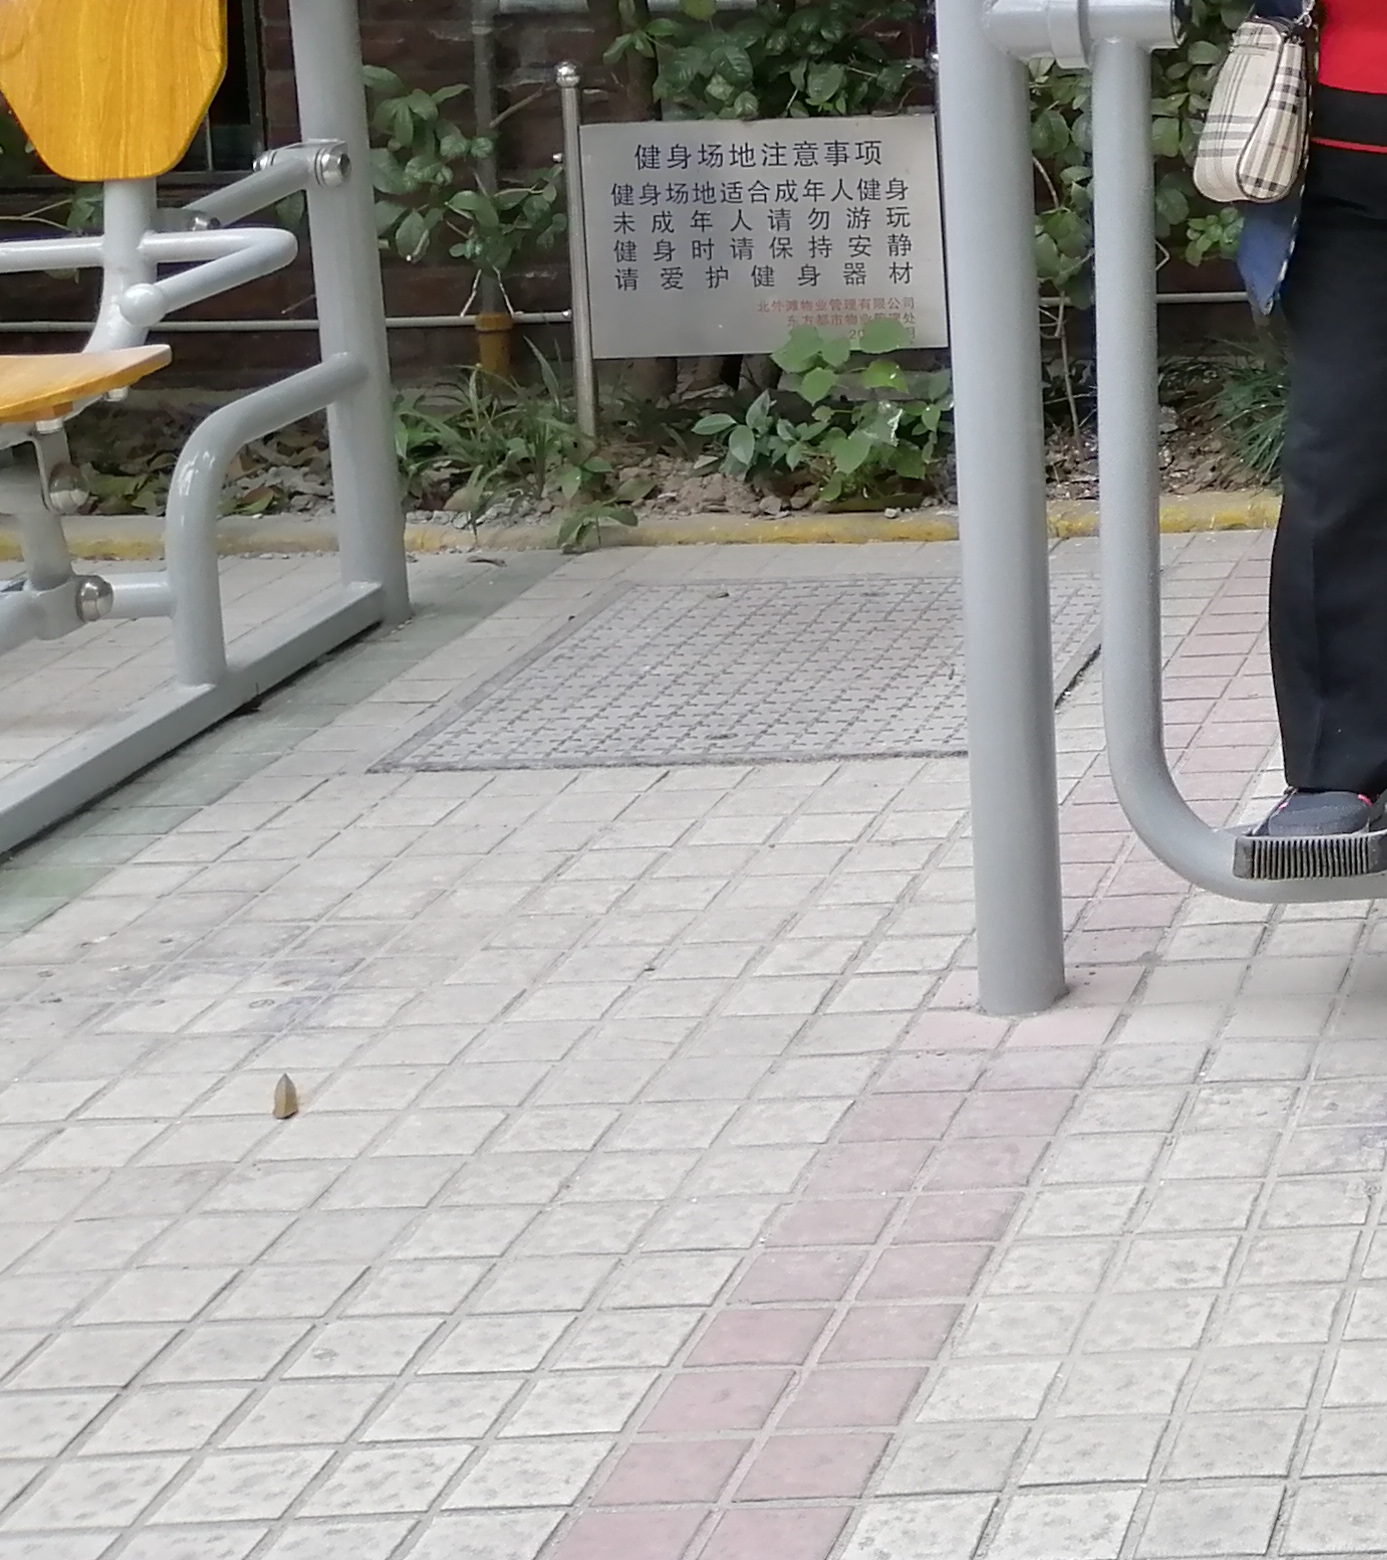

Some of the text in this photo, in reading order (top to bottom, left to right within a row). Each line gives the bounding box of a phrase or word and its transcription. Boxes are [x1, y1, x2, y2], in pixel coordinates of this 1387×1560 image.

[634, 139, 883, 171] 健身场地注意事项
[610, 177, 910, 206] 健身场地适合成年人健身
[613, 206, 912, 235] 未成年人请勿游玩
[614, 234, 913, 263] 健身时请保持安静
[615, 262, 914, 291] 请爱护健身器材
[757, 296, 915, 312] 北外滩物业管理有限公司
